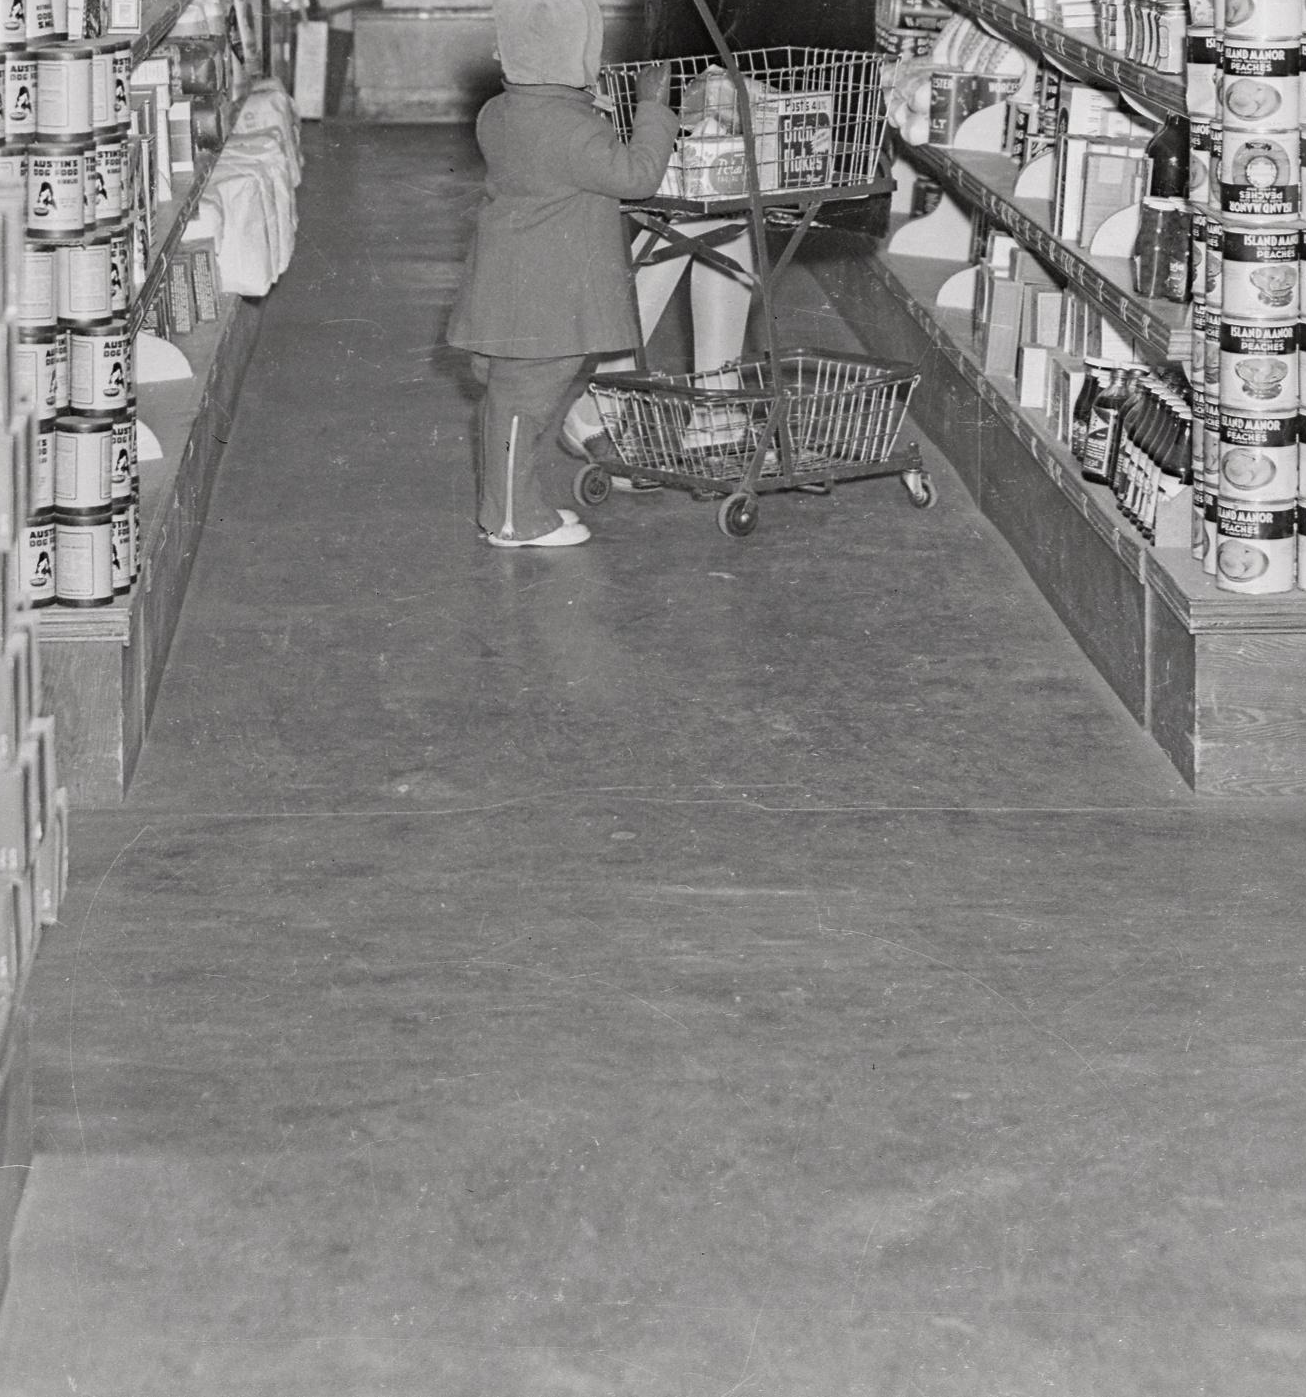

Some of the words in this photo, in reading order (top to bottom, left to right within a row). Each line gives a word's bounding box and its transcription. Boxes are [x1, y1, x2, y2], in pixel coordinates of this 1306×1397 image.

[1249, 50, 1286, 61] MANOR
[1230, 62, 1272, 72] PEACHES
[989, 82, 1019, 92] WORCES
[933, 118, 947, 129] LT
[33, 160, 78, 168] AUSTIN'S
[33, 168, 51, 177] DOG
[55, 168, 78, 177] FOOD
[1239, 190, 1283, 200] PEACHES
[1229, 202, 1264, 213] MANOR
[1244, 235, 1276, 246] ISLAND
[1256, 249, 1295, 259] PEACHES
[1230, 326, 1262, 338] ISLAND
[1263, 327, 1293, 338] MANOR
[1241, 341, 1284, 351] PEACHES
[1244, 419, 1281, 431] MANOR
[1227, 431, 1268, 442] PEACHES
[1236, 511, 1273, 524] MANOR
[1220, 524, 1260, 535] PEACHES
[29, 539, 48, 548] DOG
